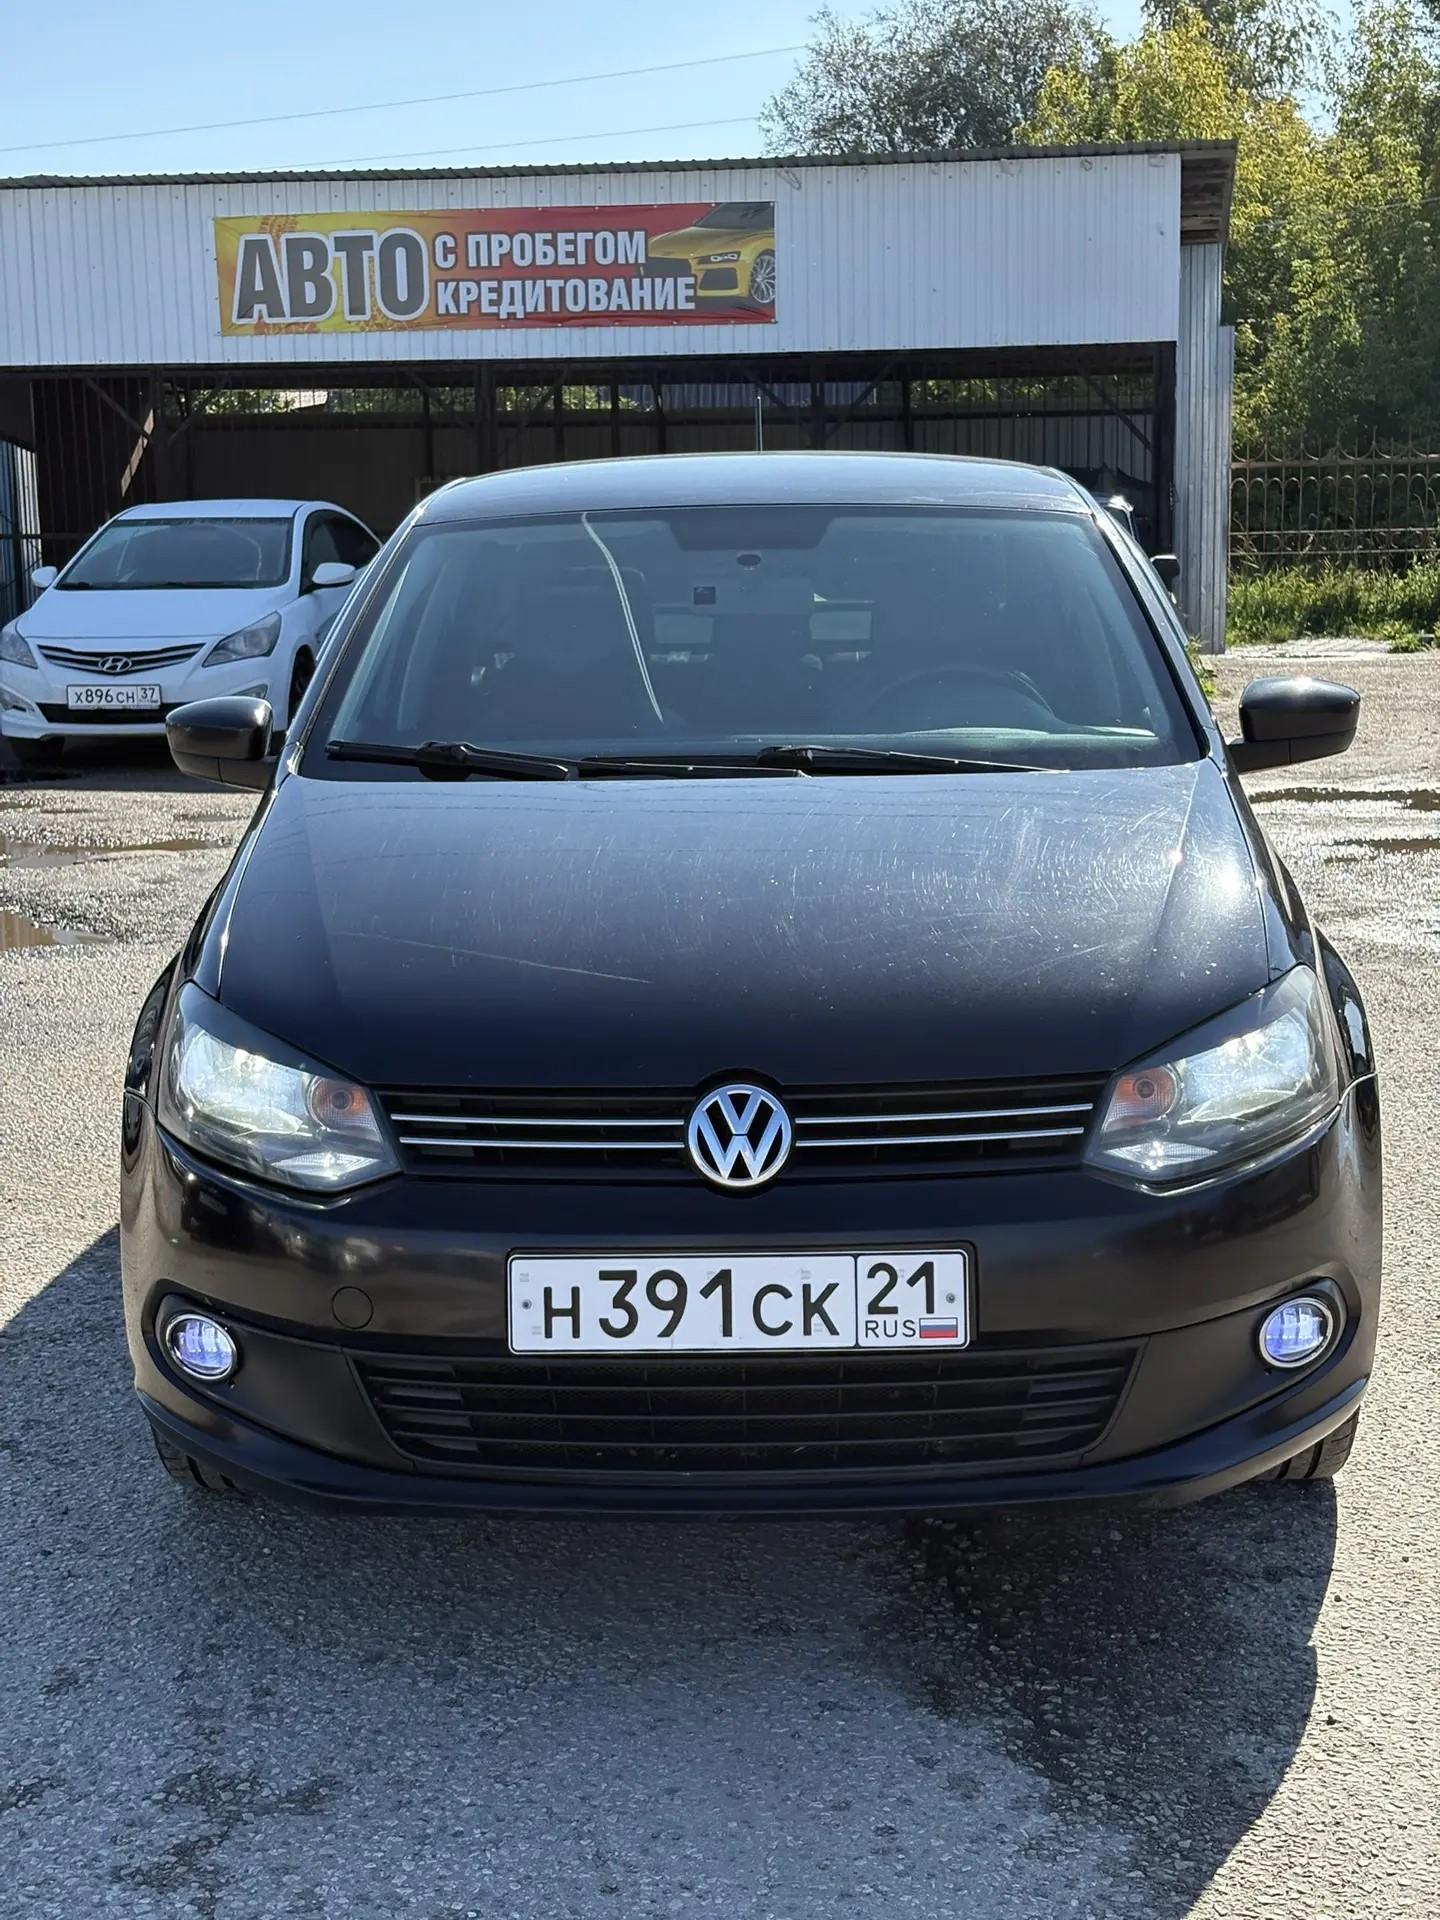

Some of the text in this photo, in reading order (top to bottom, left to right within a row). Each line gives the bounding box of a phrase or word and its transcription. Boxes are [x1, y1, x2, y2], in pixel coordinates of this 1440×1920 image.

[433, 230, 646, 270] С ПРОБЕГОМ
[232, 228, 430, 324] АВТО
[436, 276, 696, 320] КРЕДИТОВАНИЕ
[140, 687, 156, 699] 37
[867, 1261, 935, 1315] 21
[865, 1319, 917, 1339] RUS
